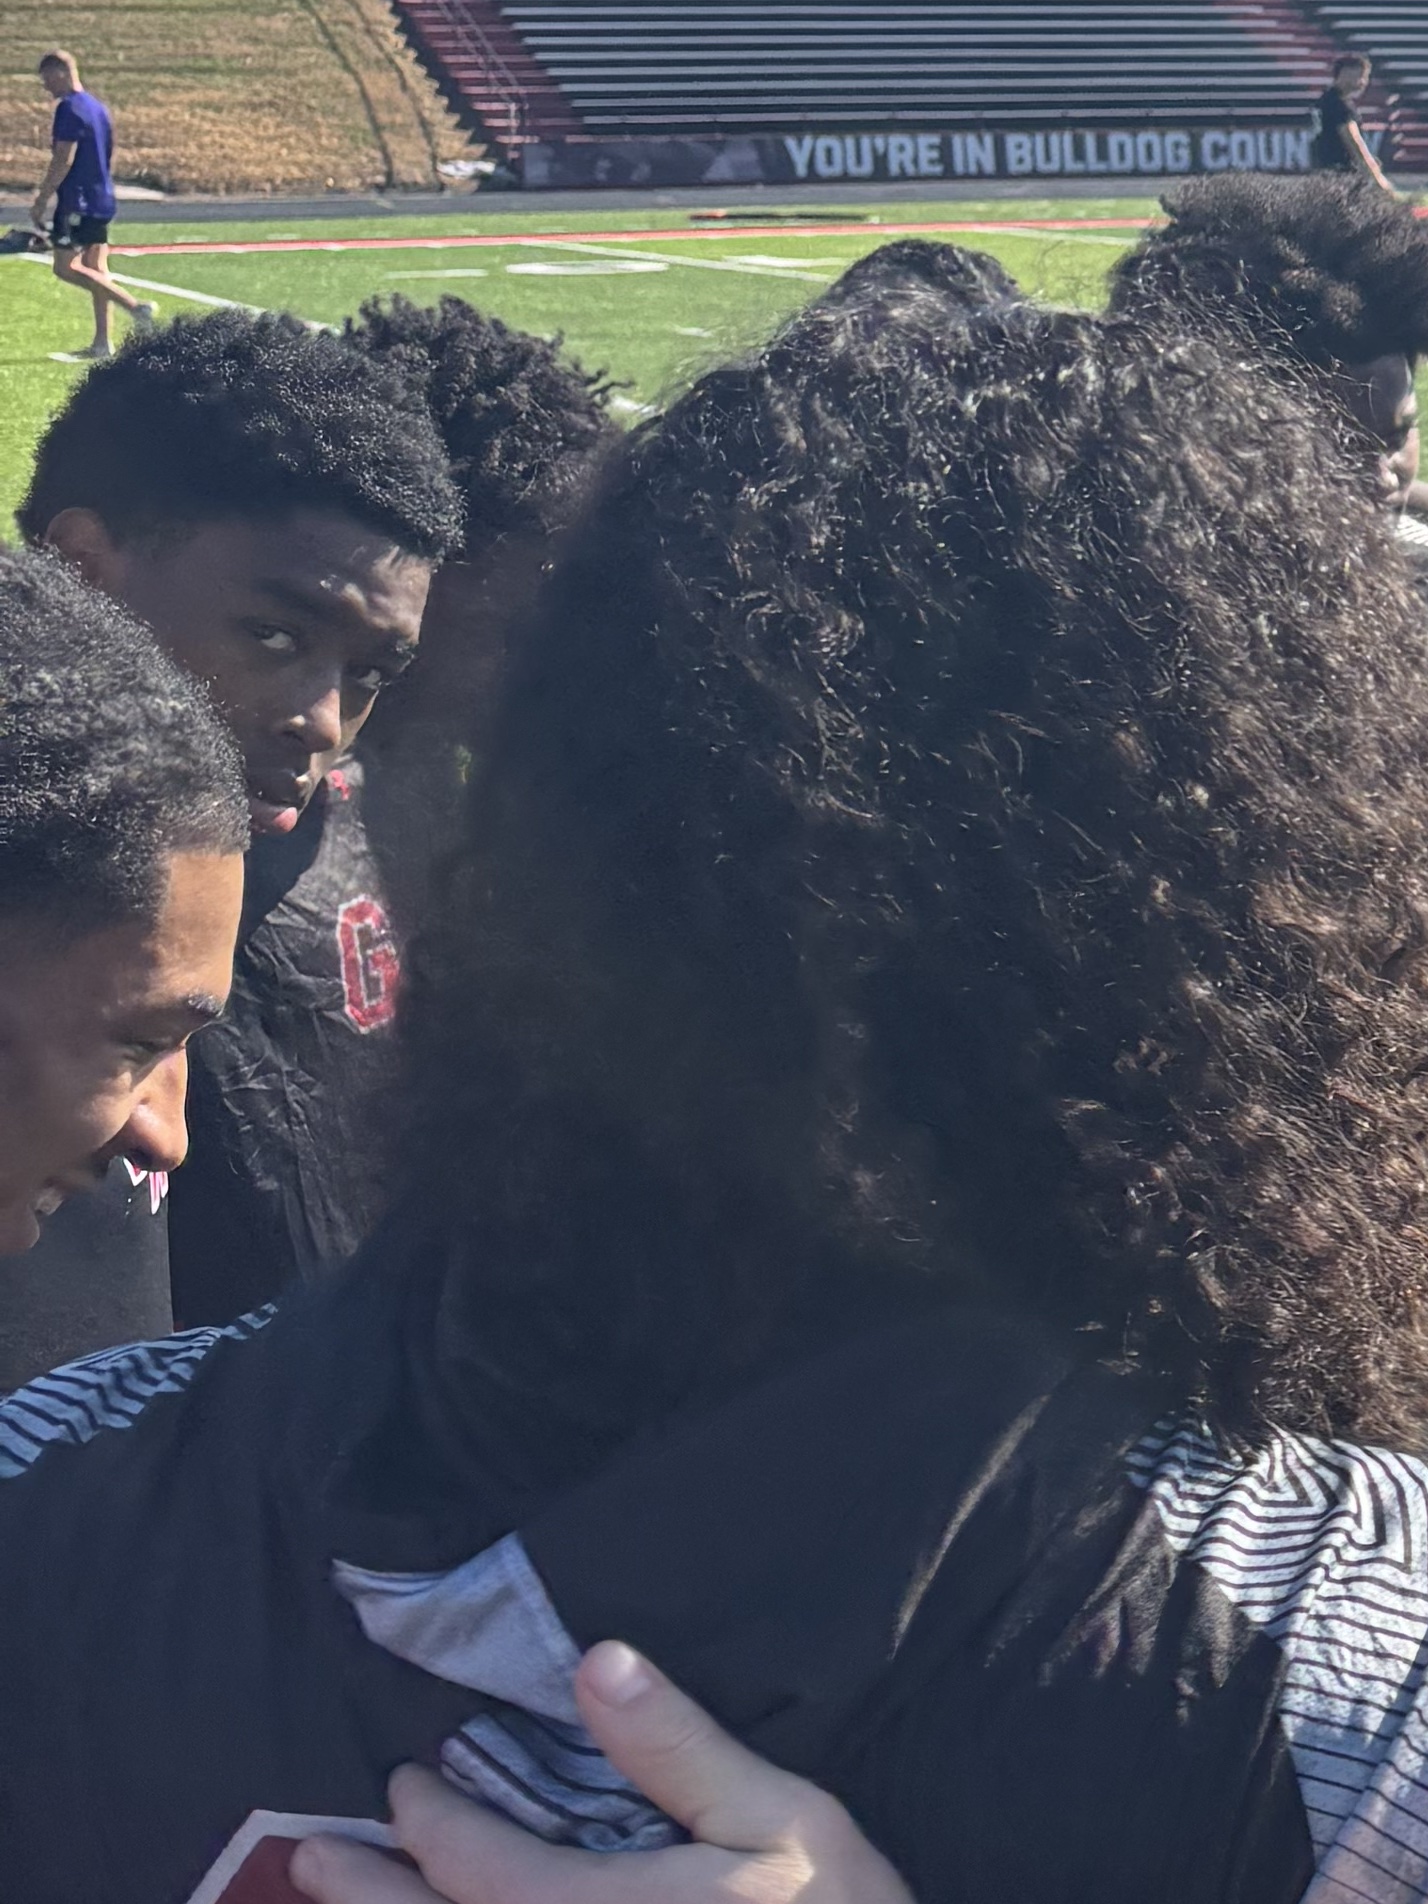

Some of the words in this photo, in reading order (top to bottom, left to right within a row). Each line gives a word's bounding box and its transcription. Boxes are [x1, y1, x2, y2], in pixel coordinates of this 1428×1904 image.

[785, 132, 944, 178] YOU'RE
[952, 131, 997, 175] IN
[1004, 127, 1192, 175] BULLDOG
